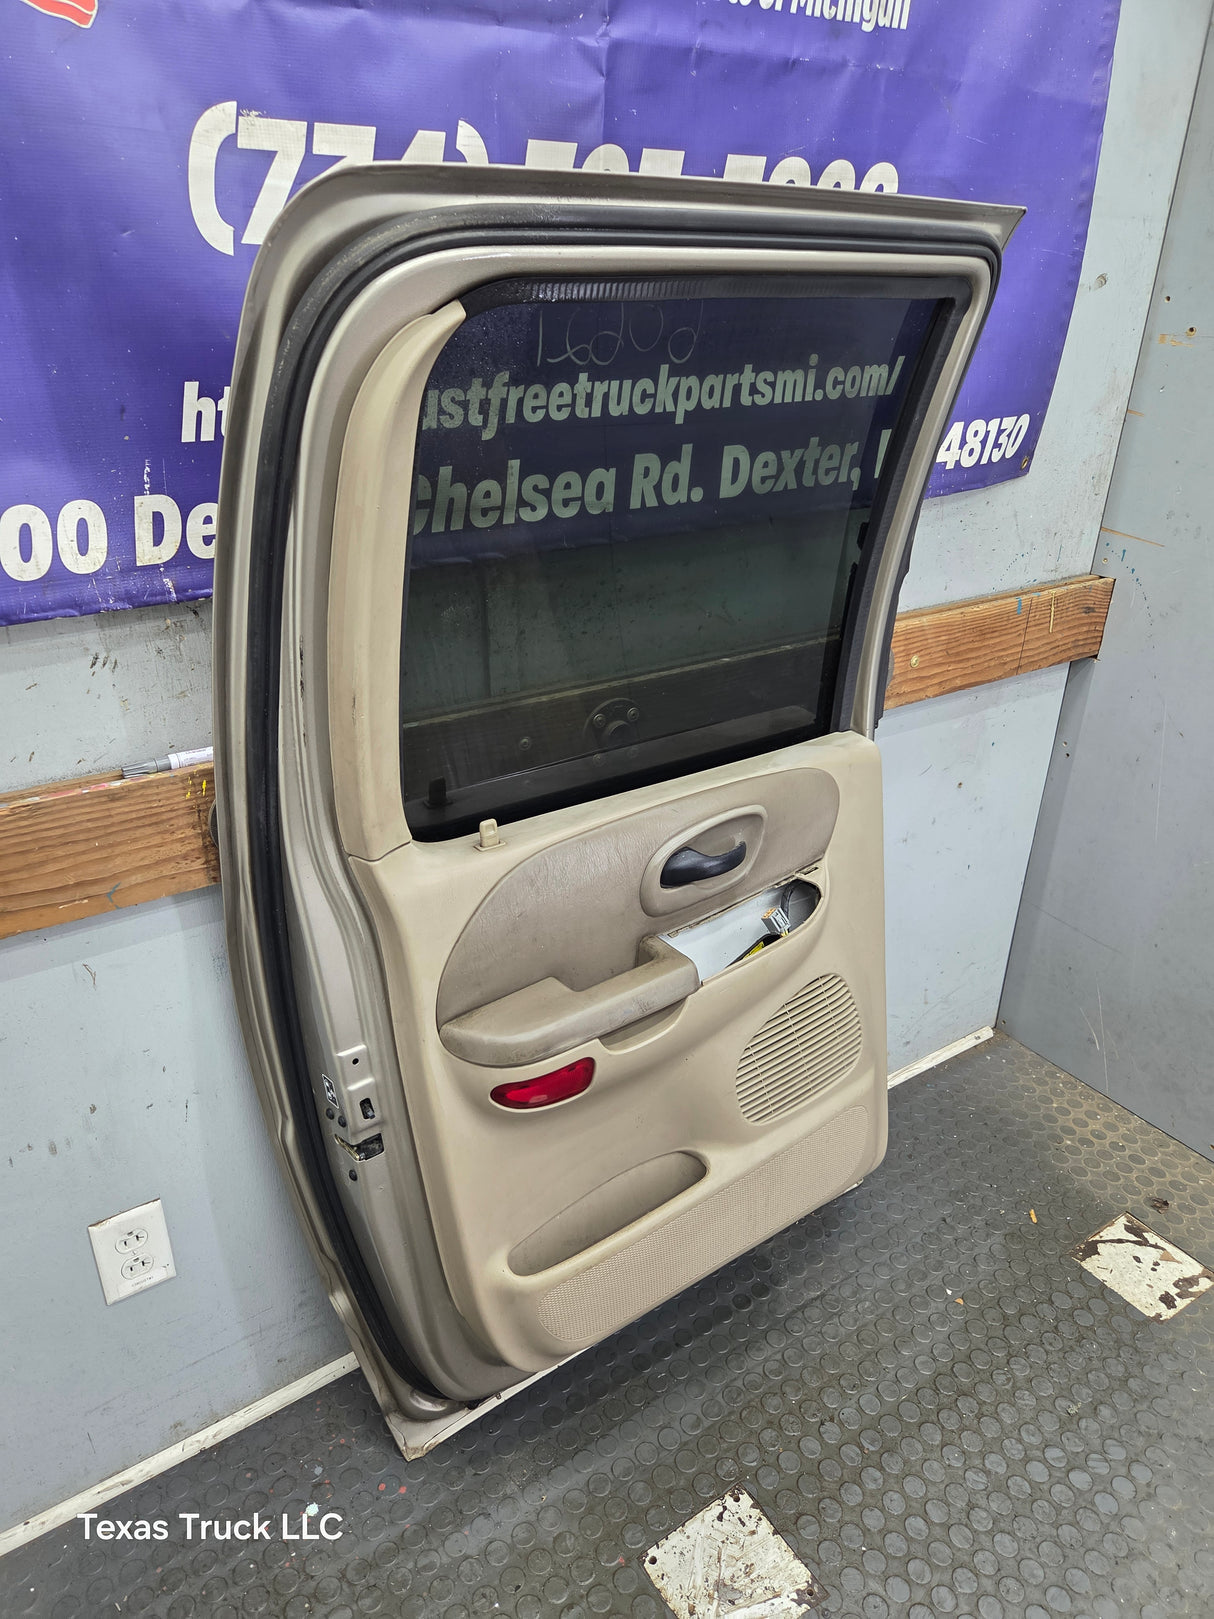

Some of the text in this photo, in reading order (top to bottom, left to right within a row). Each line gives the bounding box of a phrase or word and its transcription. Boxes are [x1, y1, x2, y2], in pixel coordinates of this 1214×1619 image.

[629, 443, 704, 510] Rd.
[719, 436, 861, 499] Dexter,
[936, 413, 1031, 470] 48130
